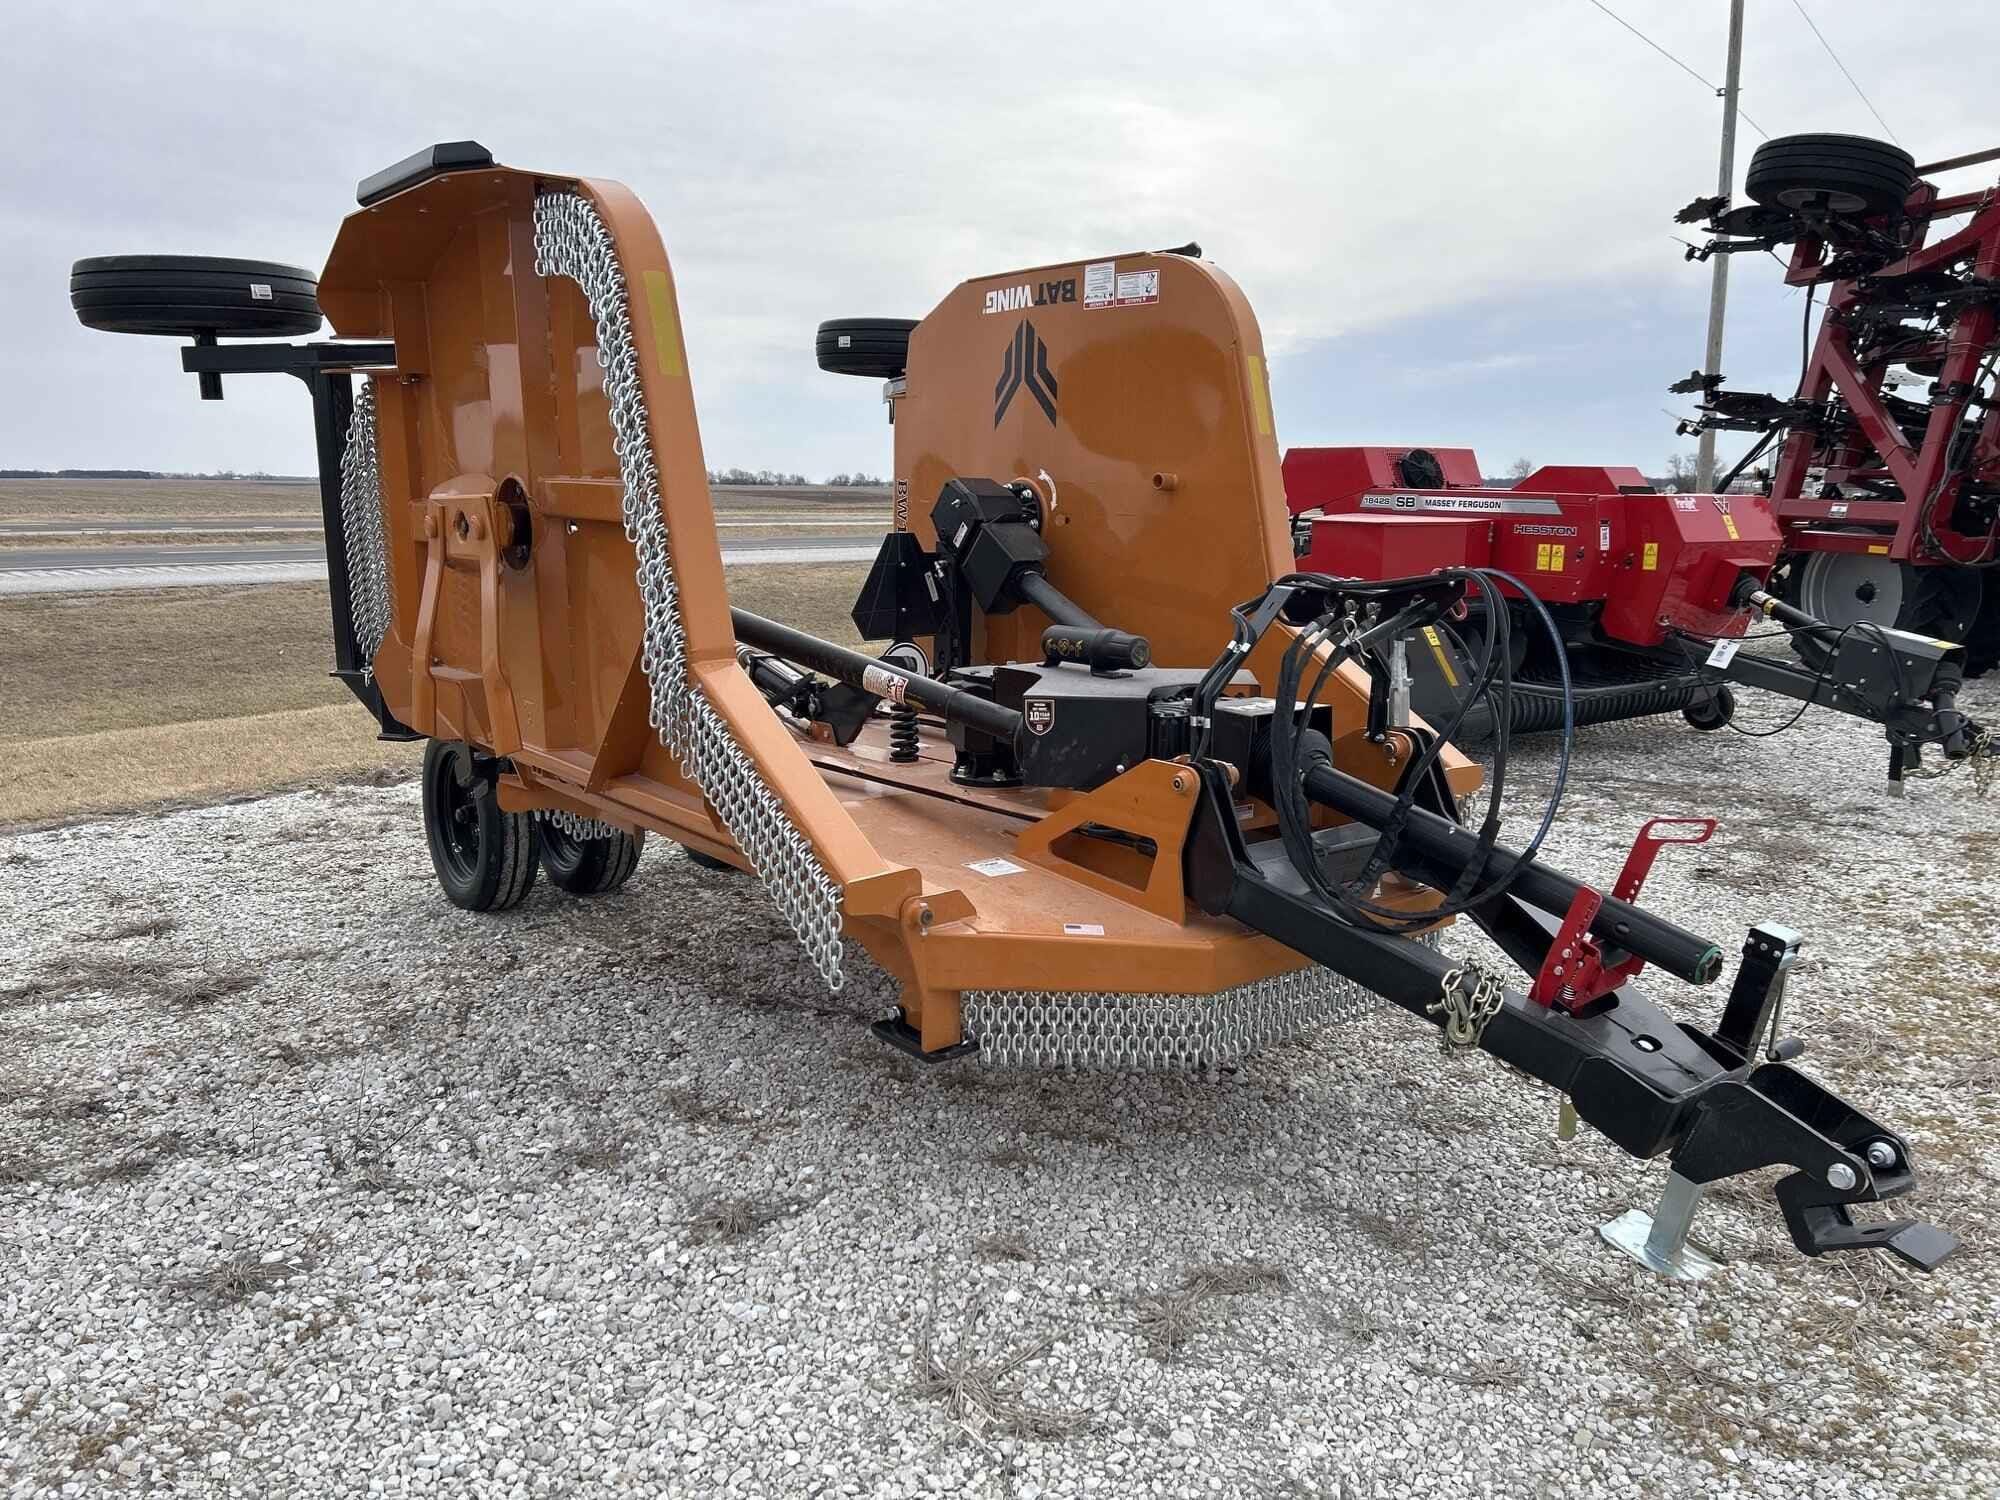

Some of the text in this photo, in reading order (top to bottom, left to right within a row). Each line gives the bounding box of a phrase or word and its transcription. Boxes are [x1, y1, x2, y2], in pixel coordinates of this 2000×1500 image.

[985, 284, 1034, 314] WING
[1034, 279, 1076, 306] BAT
[897, 480, 908, 533] BW1
[1396, 496, 1416, 507] SB
[1424, 499, 1456, 508] MASSEY
[1458, 500, 1501, 509] FERGUSON
[1514, 524, 1577, 536] HESSTON
